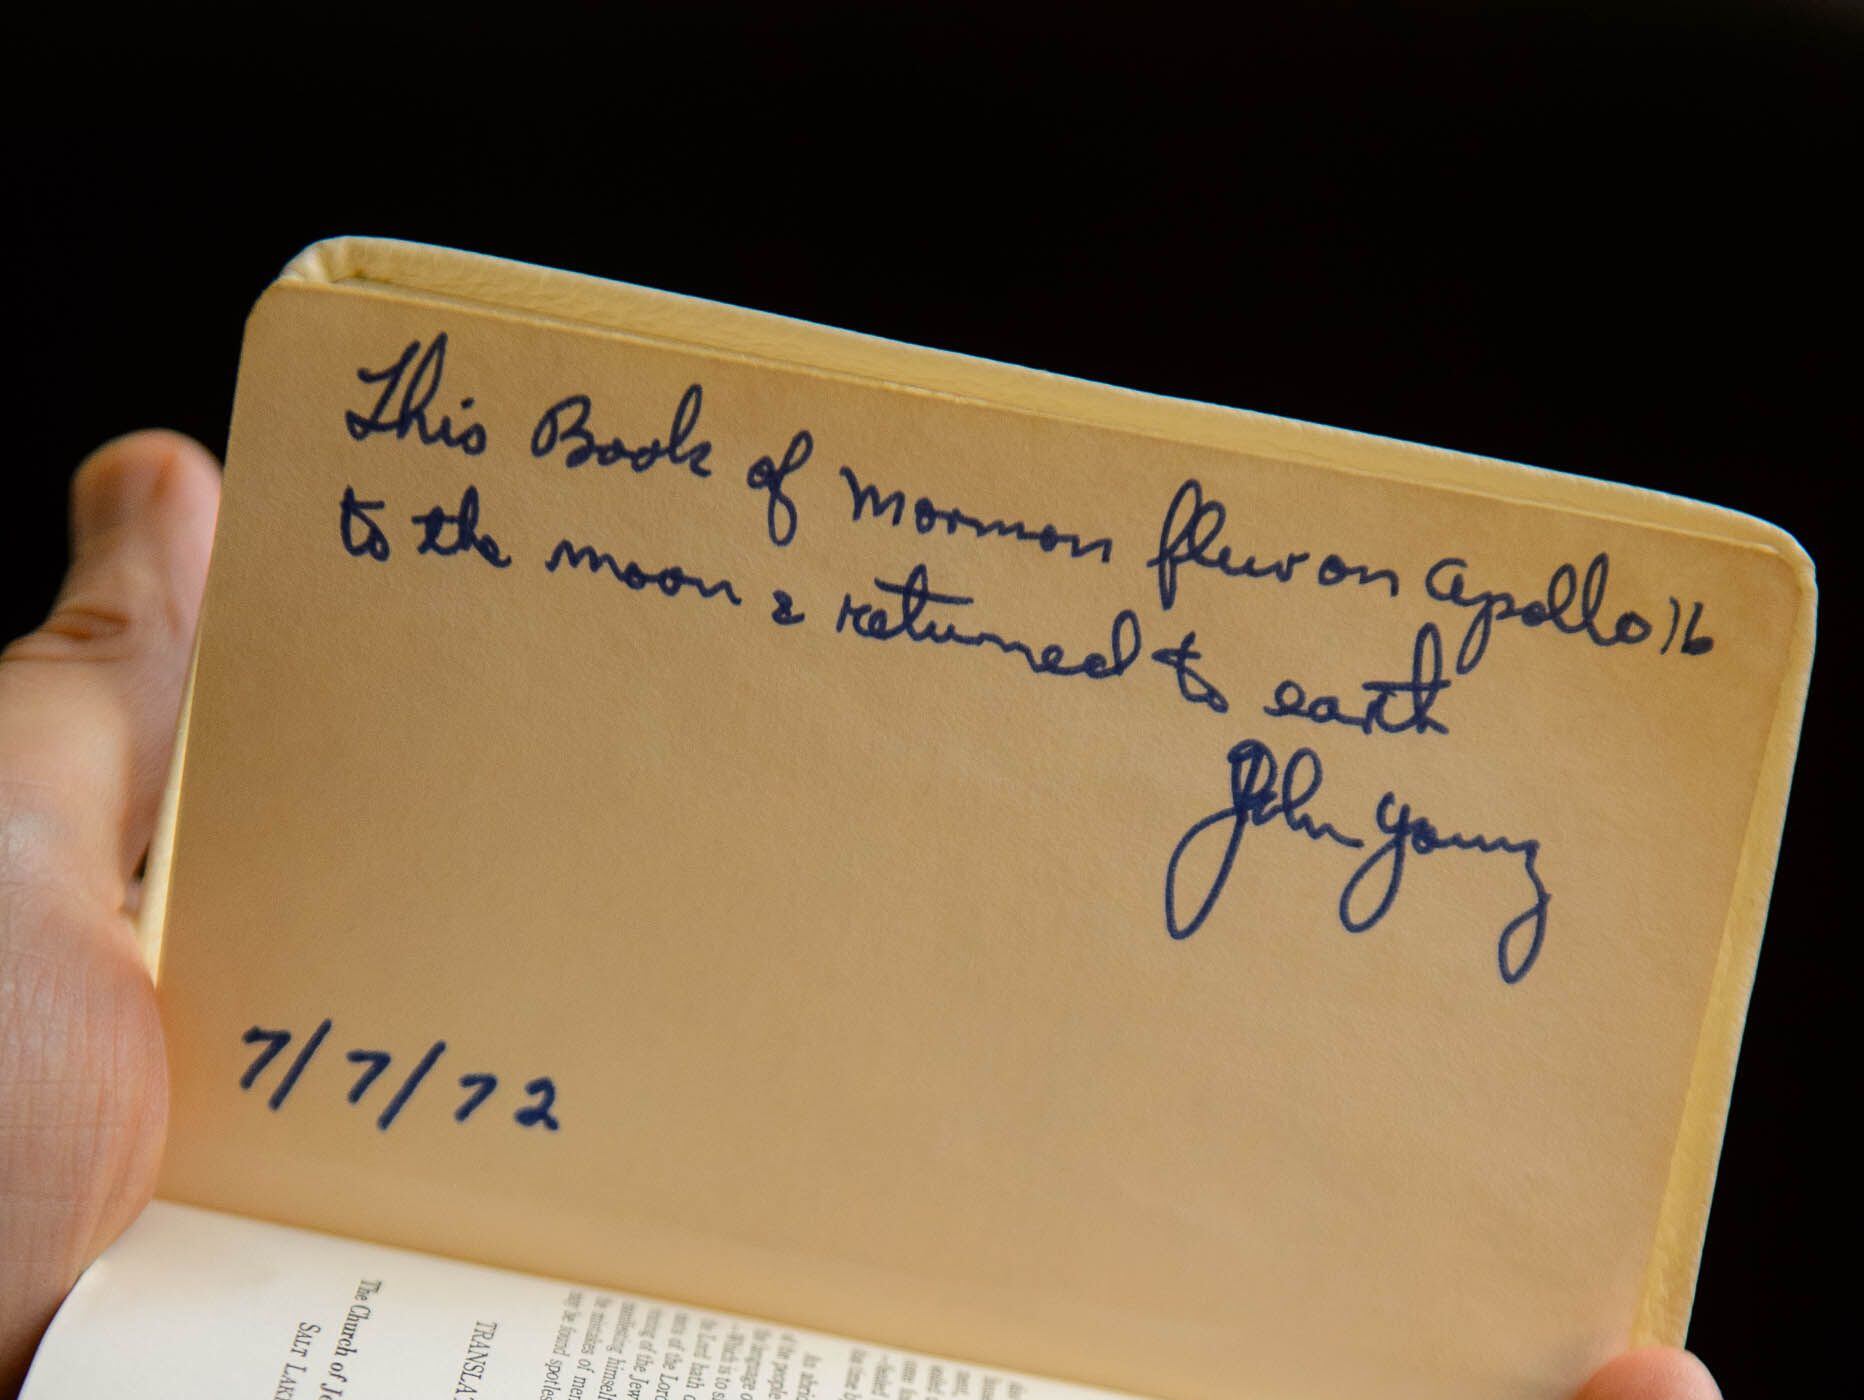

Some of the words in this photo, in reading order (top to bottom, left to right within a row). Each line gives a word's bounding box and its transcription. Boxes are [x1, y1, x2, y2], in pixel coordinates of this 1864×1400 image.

[345, 332, 488, 456] This
[530, 383, 713, 477] Book
[746, 430, 814, 546] of
[1146, 478, 1310, 610] flew
[1317, 560, 1400, 598] on
[338, 485, 390, 562] to
[411, 485, 511, 568] the
[545, 540, 742, 605] moon
[836, 563, 1142, 678] returned
[1152, 632, 1229, 713] to
[1262, 622, 1451, 735] earth
[1164, 738, 1364, 940] John
[239, 1016, 560, 1132] 7/7/72
[354, 1280, 382, 1301] The
[335, 1304, 371, 1356] Church
[329, 1362, 348, 1383] of
[577, 1358, 595, 1374] of
[714, 1377, 731, 1390] to
[627, 1374, 650, 1400] Jew
